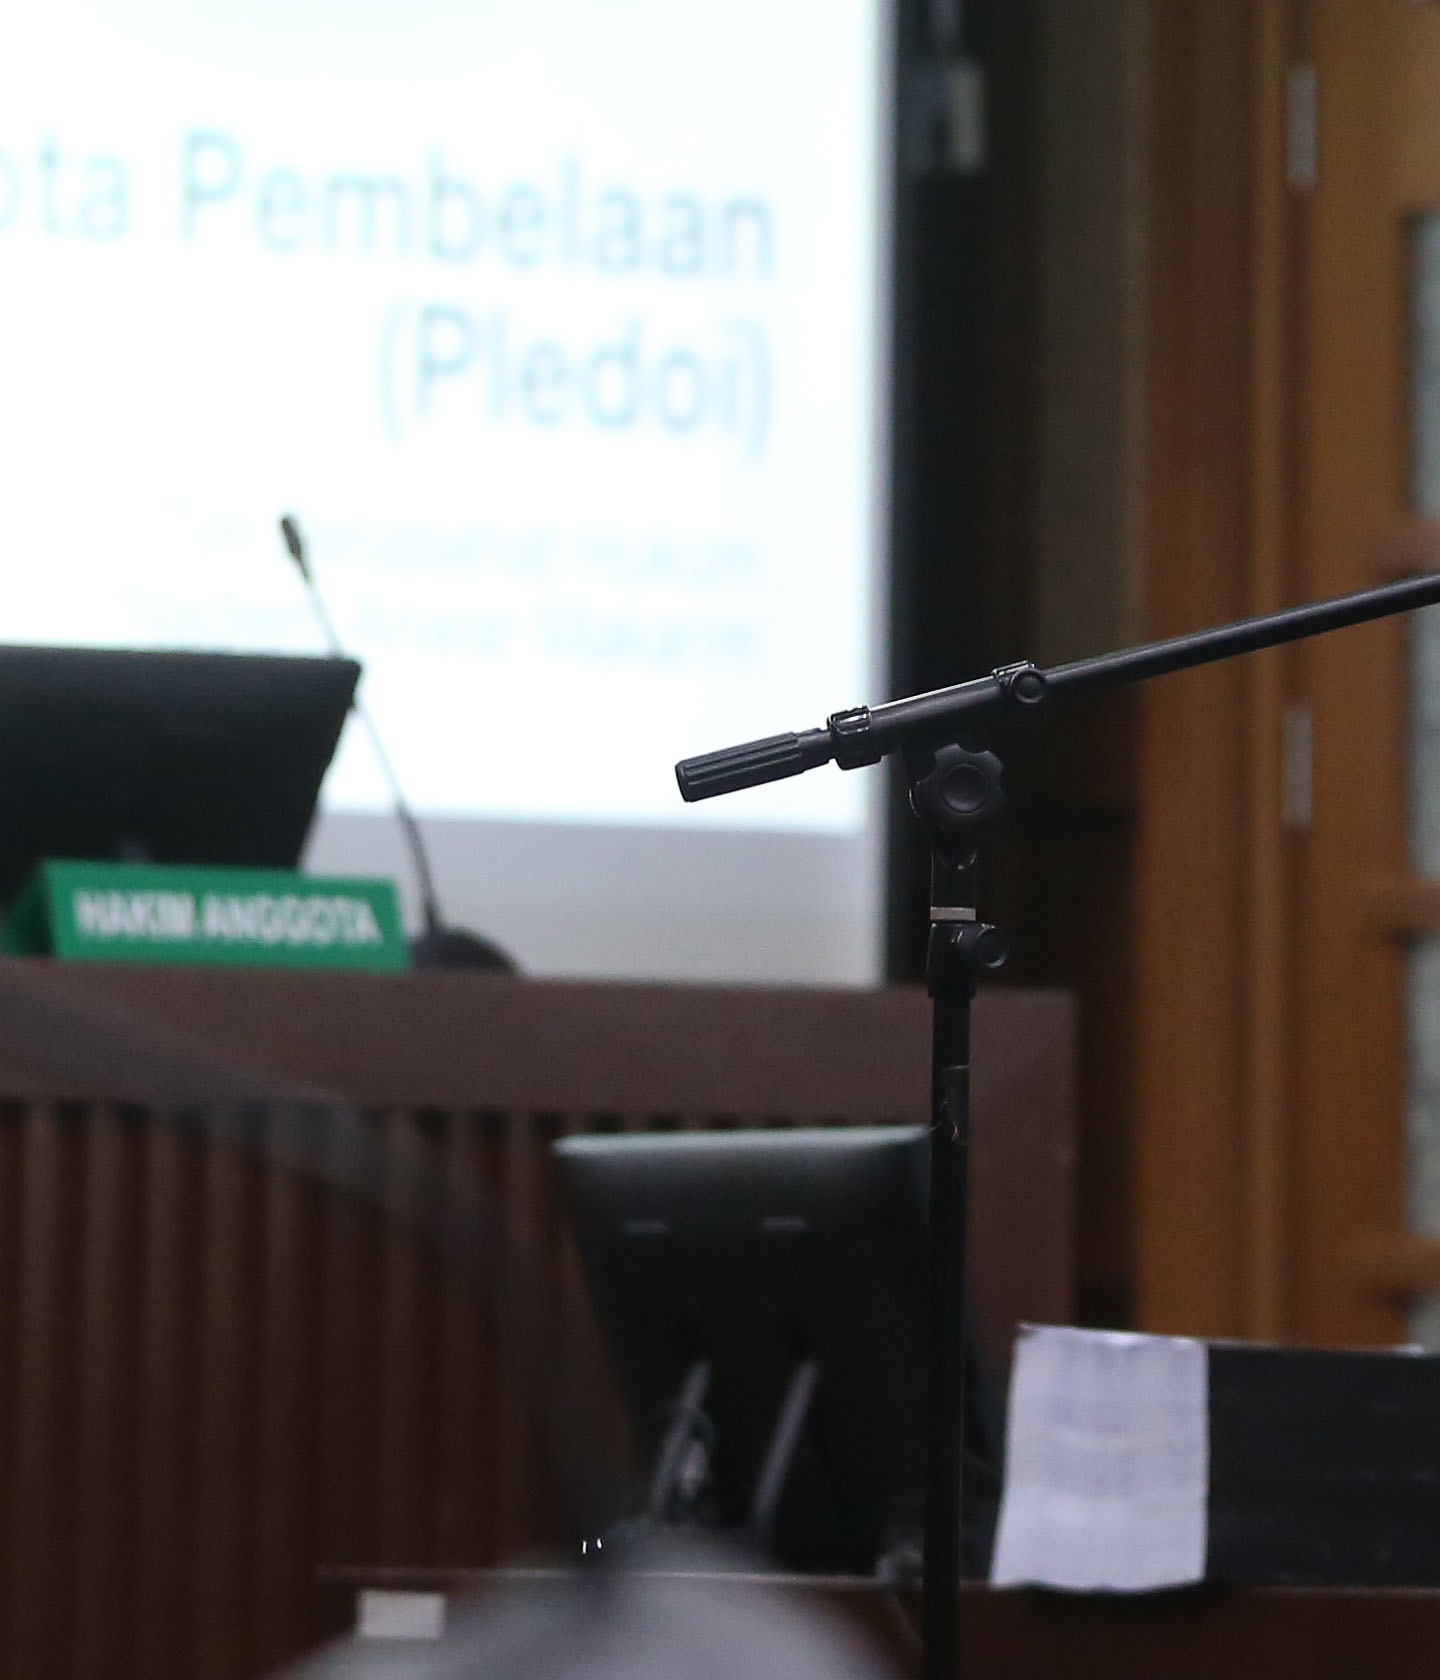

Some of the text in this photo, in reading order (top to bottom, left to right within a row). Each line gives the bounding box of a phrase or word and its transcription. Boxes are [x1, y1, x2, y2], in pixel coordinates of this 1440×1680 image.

[178, 128, 776, 280] Pembelaan
[374, 301, 775, 460] (Pledoi)
[73, 889, 383, 947] HAKIM ANGGOTA
